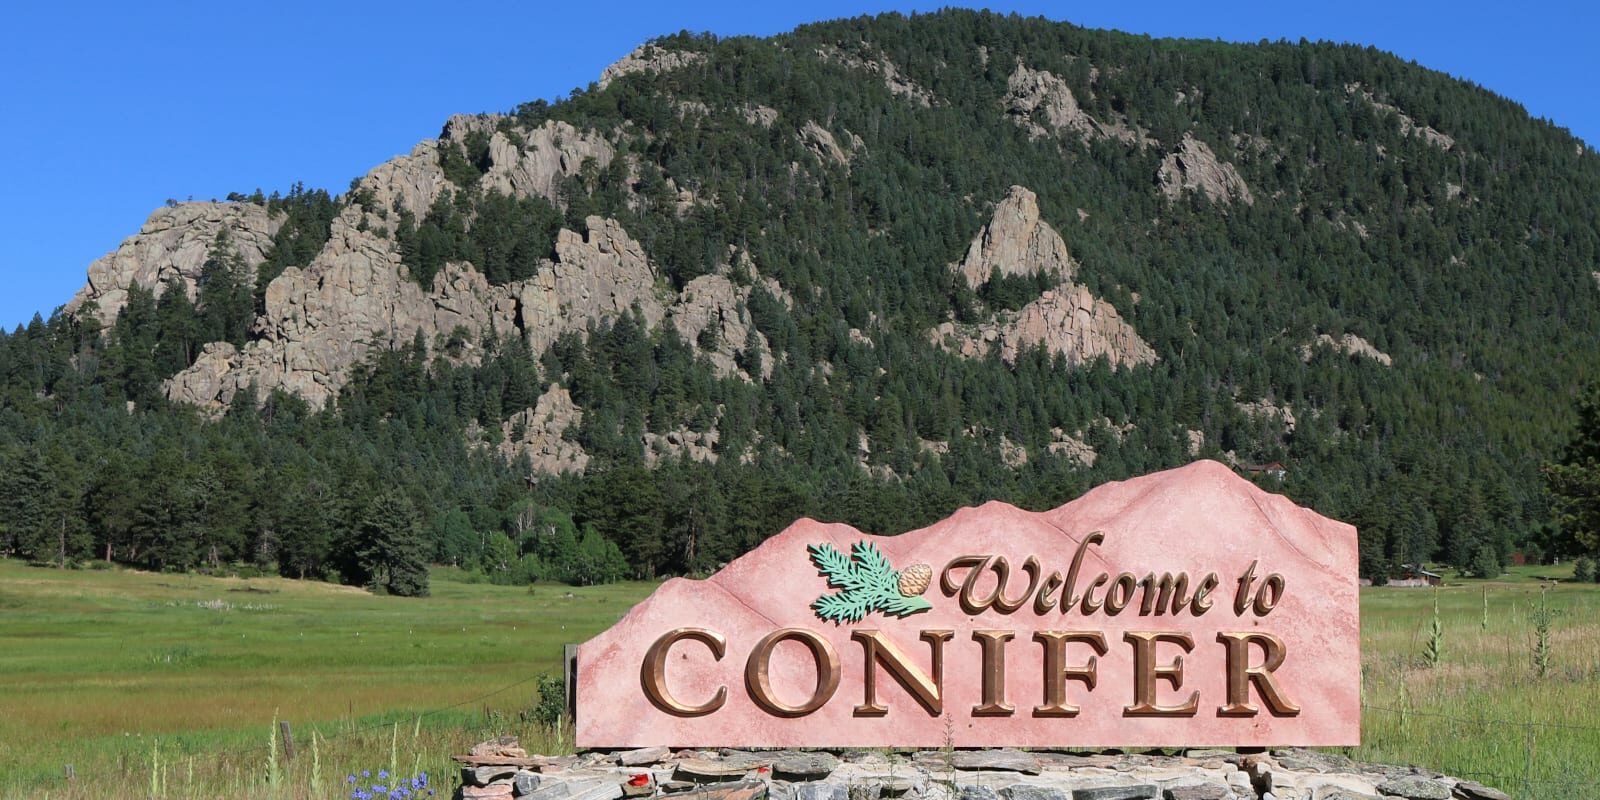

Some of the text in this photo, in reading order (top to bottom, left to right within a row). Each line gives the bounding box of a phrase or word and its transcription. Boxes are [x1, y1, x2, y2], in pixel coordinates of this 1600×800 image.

[940, 531, 1286, 617] Welcome to
[640, 627, 1301, 718] CONIFER
